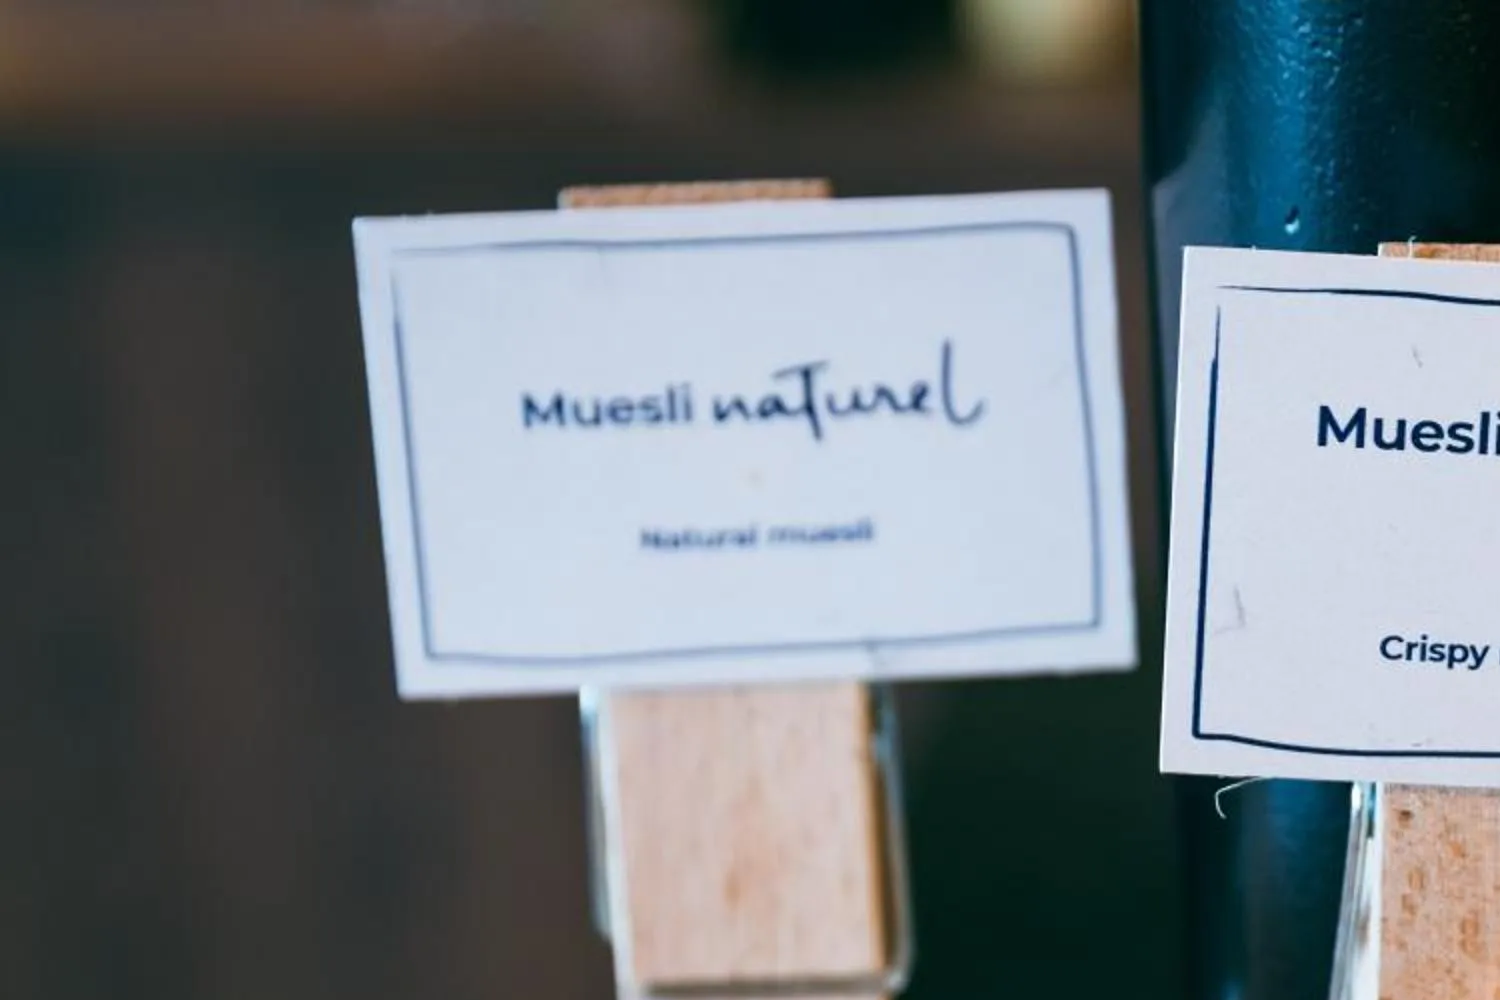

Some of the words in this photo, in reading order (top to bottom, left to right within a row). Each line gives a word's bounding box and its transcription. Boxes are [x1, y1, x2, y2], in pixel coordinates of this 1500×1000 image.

[521, 383, 694, 430] Muesli
[639, 525, 758, 552] Natural
[766, 517, 876, 545] muesli
[1379, 633, 1491, 671] Crispy
